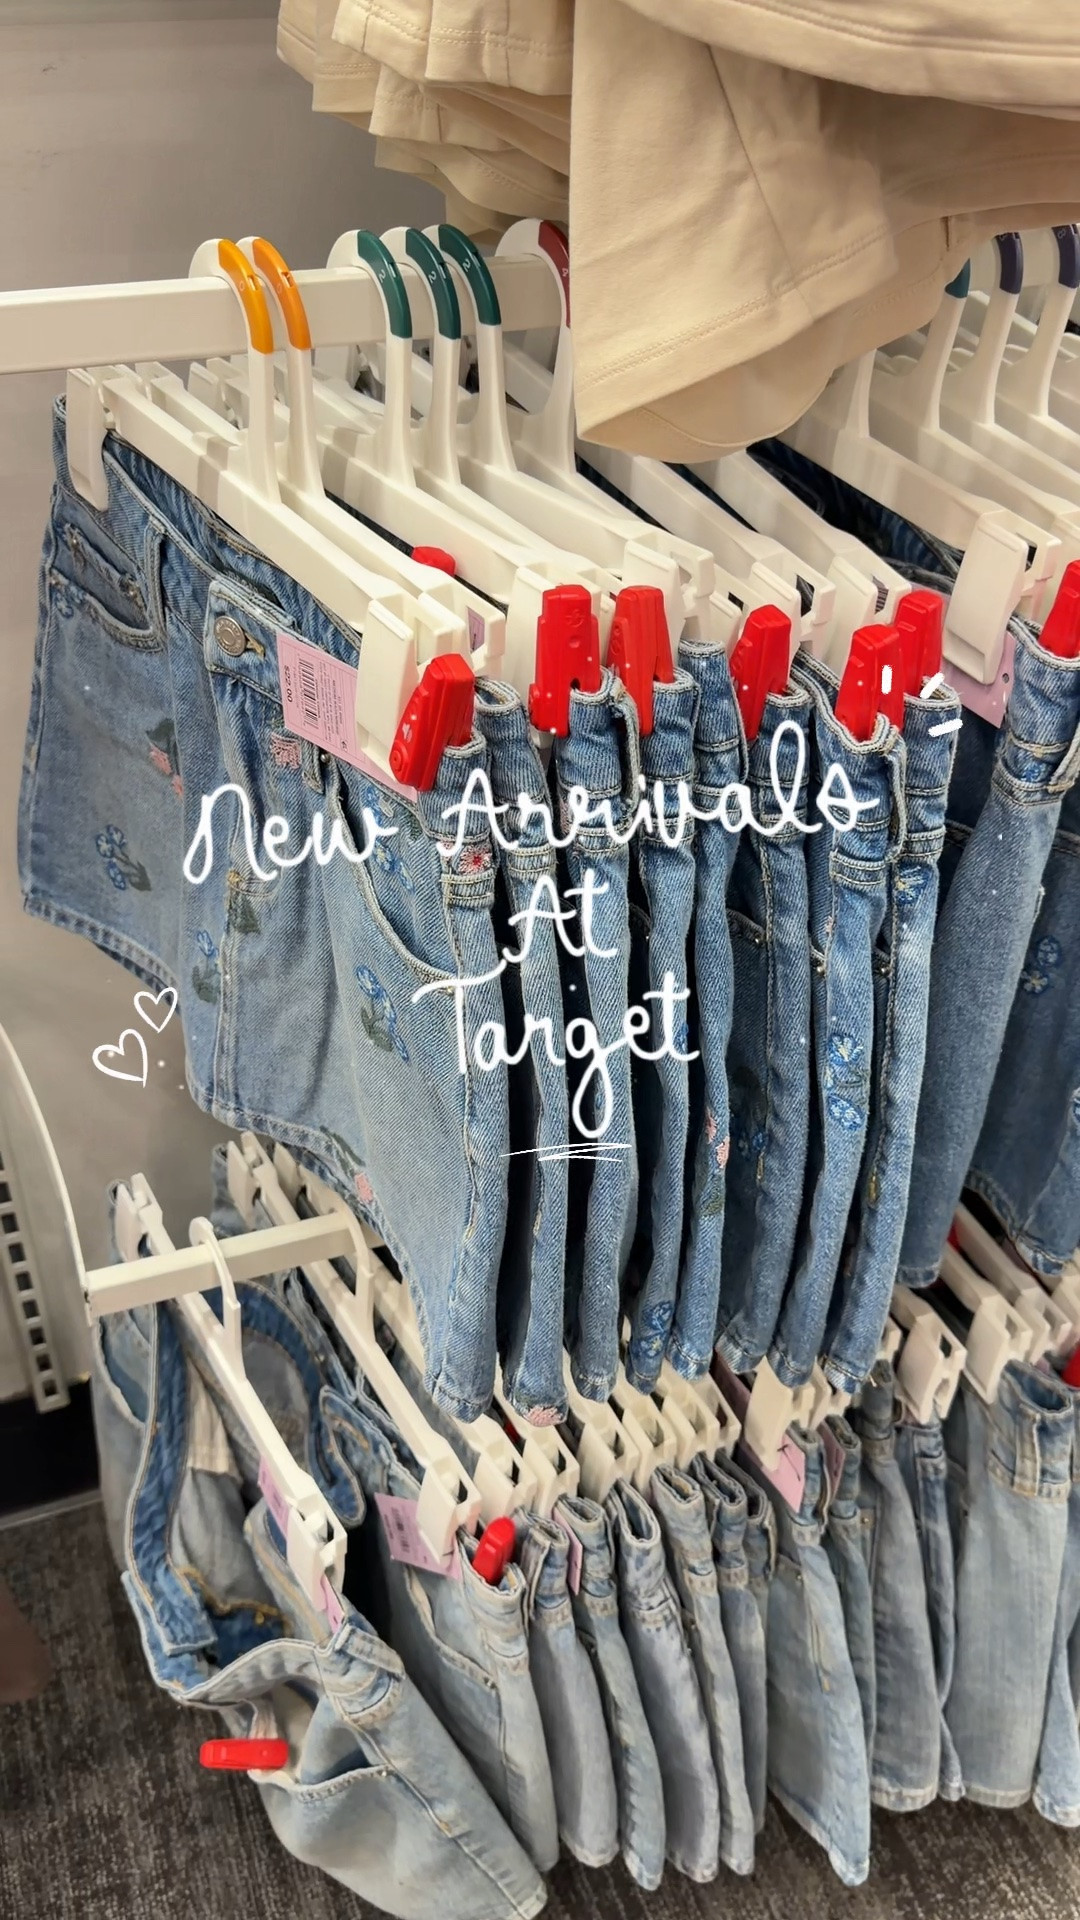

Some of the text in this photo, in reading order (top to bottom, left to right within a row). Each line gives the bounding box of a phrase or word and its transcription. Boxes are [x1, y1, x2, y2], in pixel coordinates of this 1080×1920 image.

[462, 258, 471, 272] 2
[378, 268, 386, 283] 2
[428, 270, 437, 283] 2
[284, 664, 293, 703] $22.00
